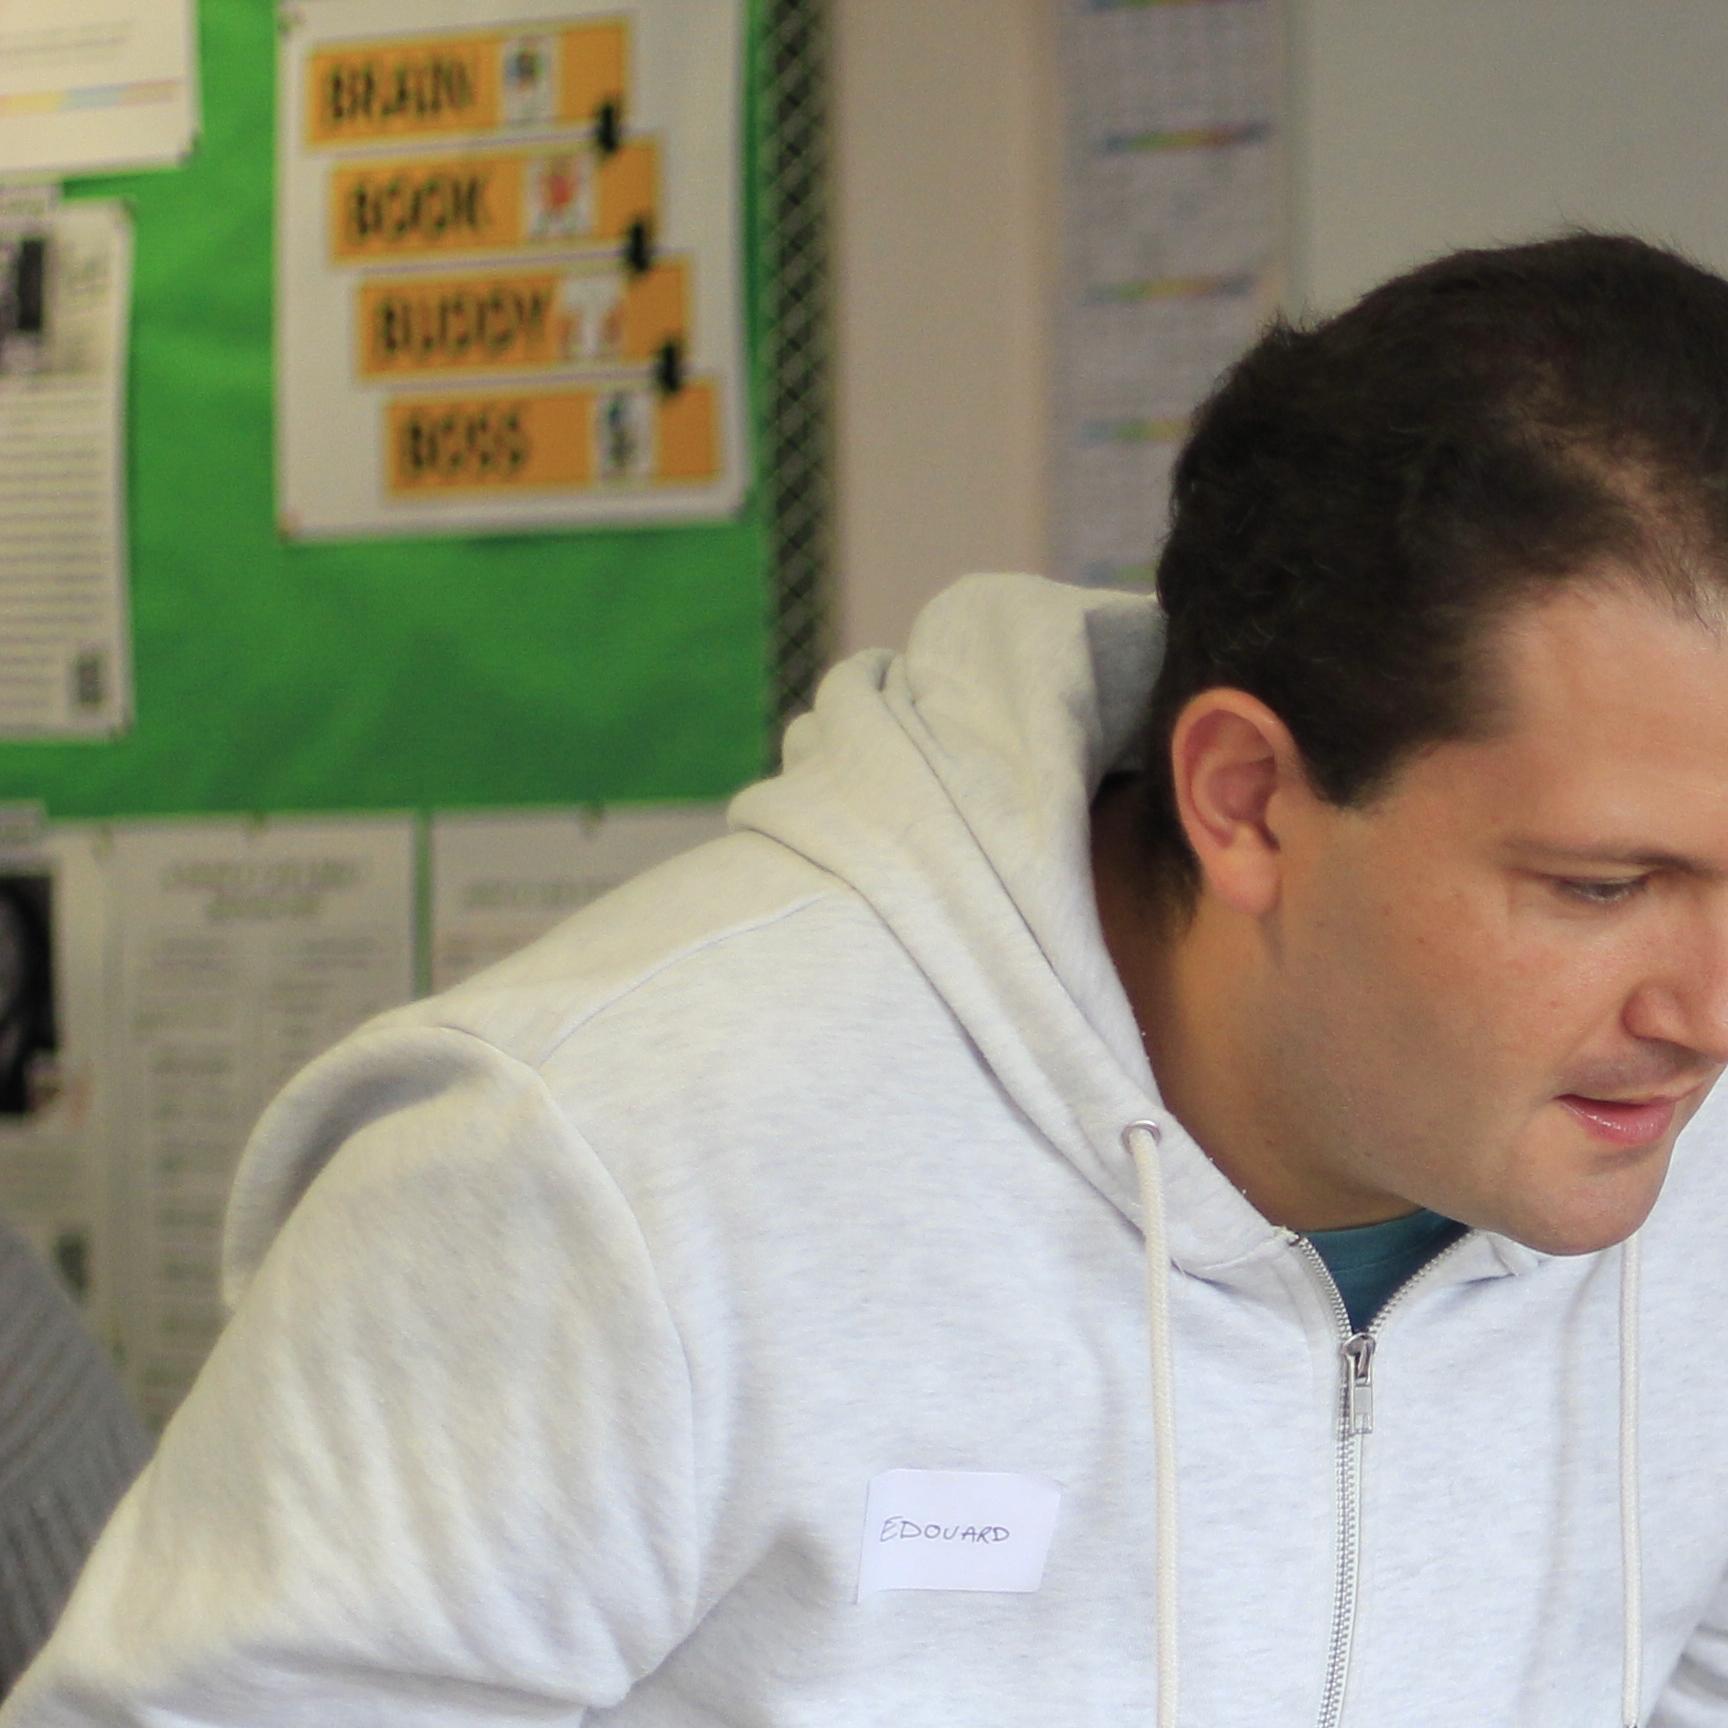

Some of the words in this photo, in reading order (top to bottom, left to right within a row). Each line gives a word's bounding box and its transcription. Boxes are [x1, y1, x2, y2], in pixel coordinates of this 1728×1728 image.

[328, 57, 476, 120] BRAIN
[351, 173, 487, 240] BOOK
[880, 1515, 1011, 1545] EDOUARD
